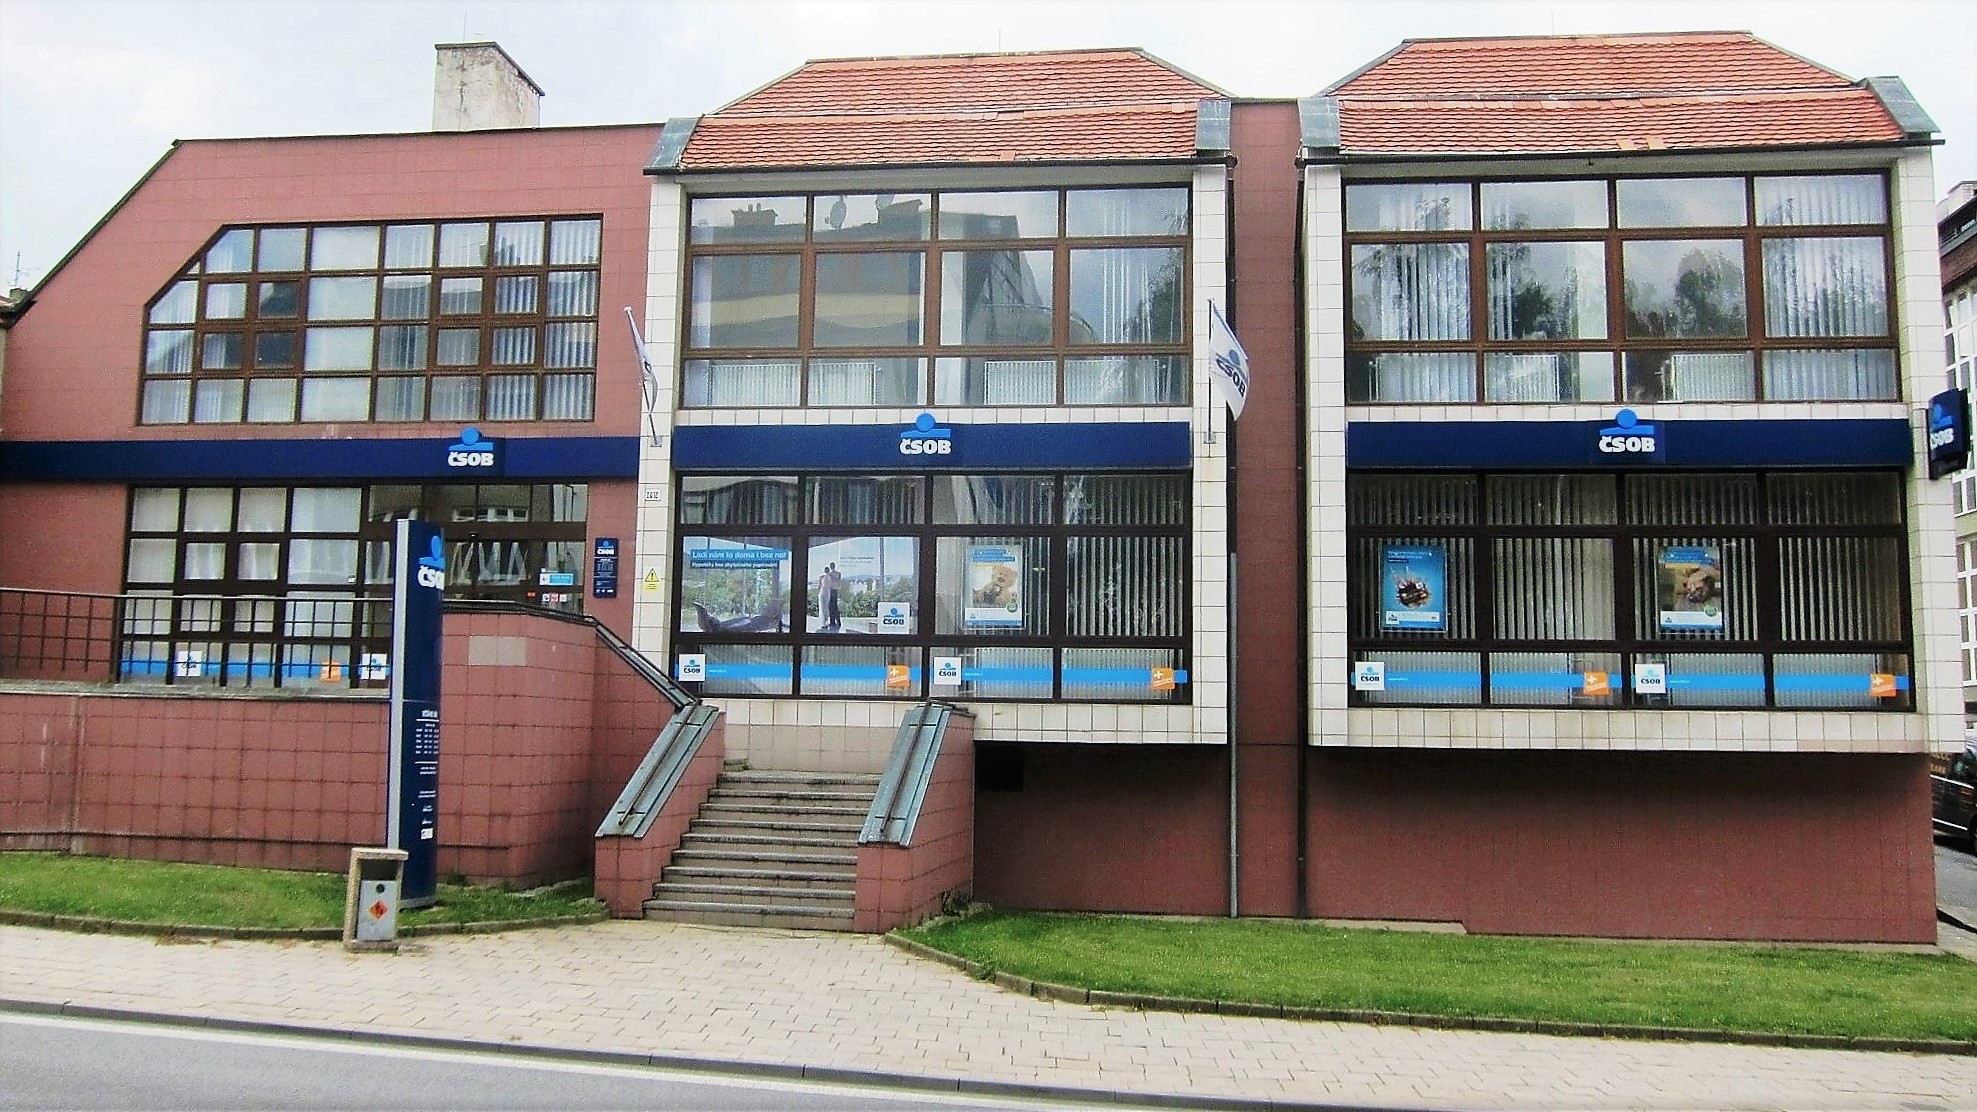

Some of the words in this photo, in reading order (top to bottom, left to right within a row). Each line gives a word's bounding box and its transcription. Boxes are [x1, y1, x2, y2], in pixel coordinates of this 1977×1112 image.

[899, 438, 952, 455] ČSOB
[1599, 435, 1656, 453] ČSOB
[448, 451, 494, 467] ČSOB
[417, 564, 445, 590] ČSO
